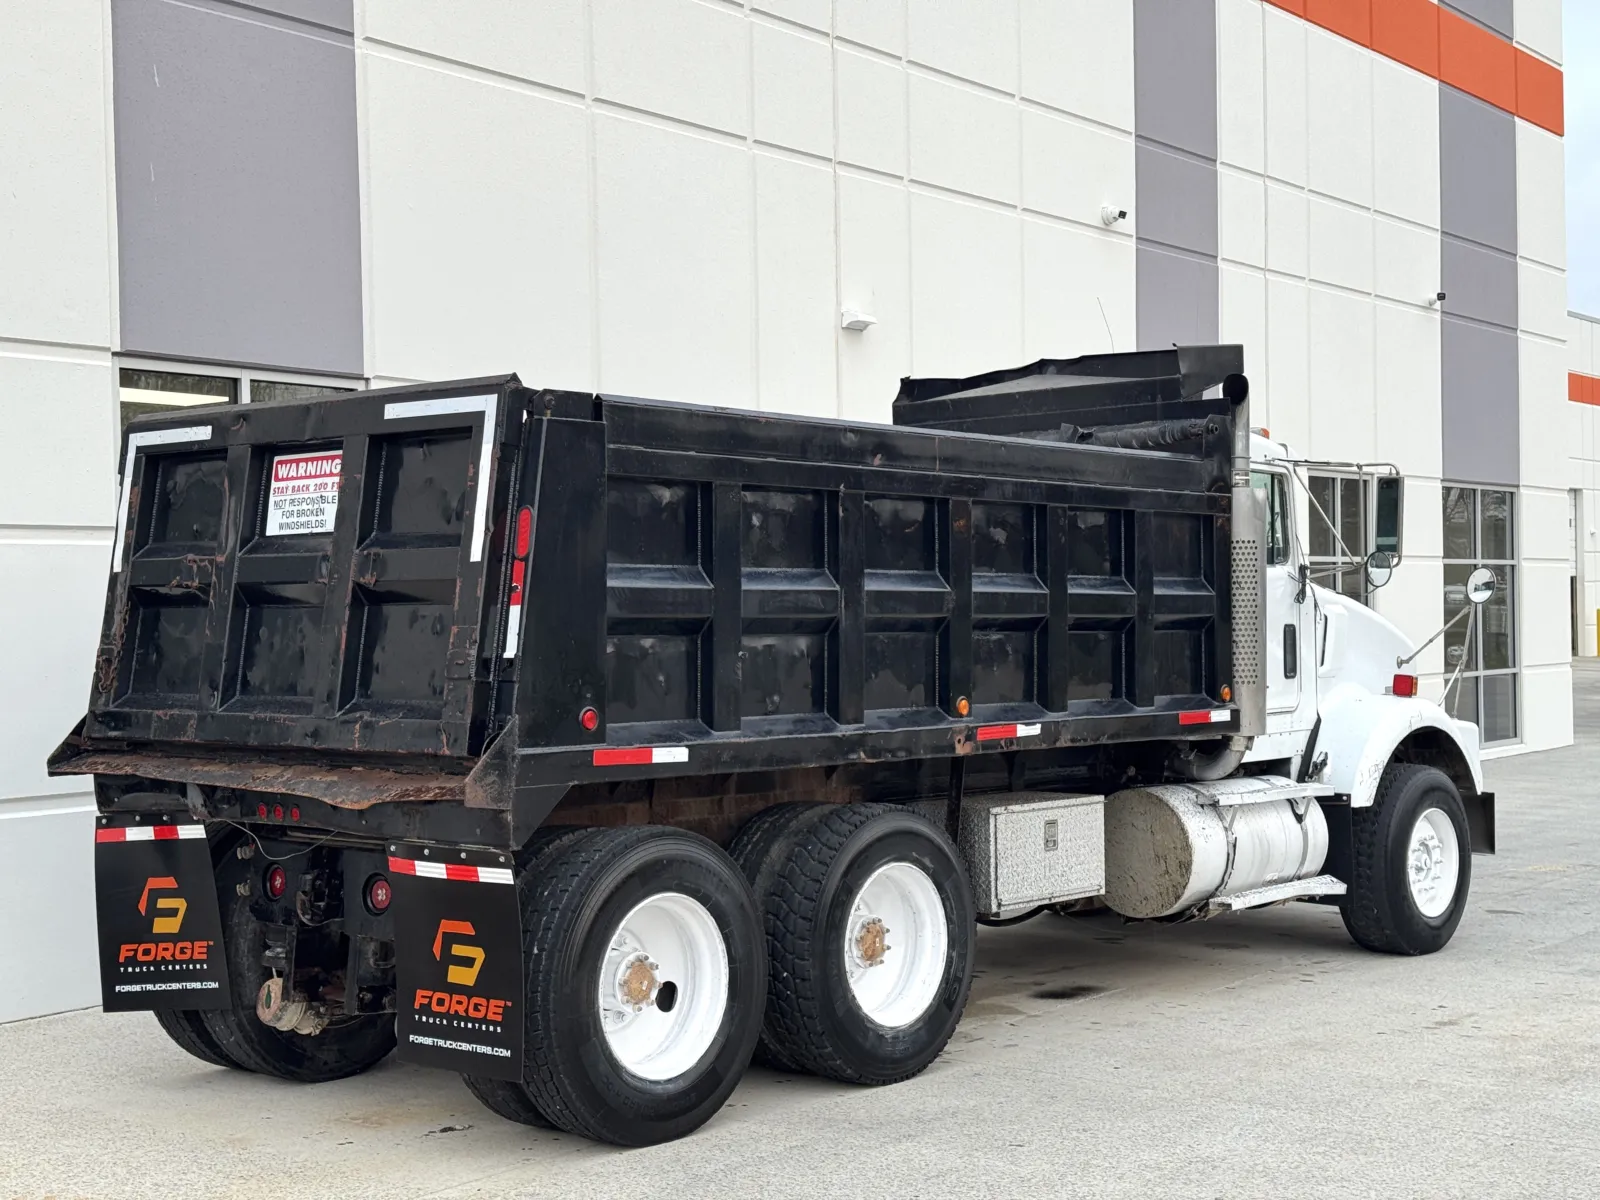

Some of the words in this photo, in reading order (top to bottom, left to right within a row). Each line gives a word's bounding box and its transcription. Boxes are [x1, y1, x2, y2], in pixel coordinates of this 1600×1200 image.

[277, 459, 342, 479] WARNING
[272, 485, 289, 495] STAY
[291, 483, 311, 494] BACK
[313, 482, 328, 491] 200
[273, 498, 288, 509] NOT
[281, 509, 295, 519] FOR
[296, 507, 325, 518] BROKEN
[279, 519, 326, 531] WINDSHIELDS!
[115, 982, 219, 992] FORGETRUCKCENTERS.COM
[415, 1015, 447, 1025] TRUCK
[453, 1021, 501, 1032] CENTERS
[409, 1035, 511, 1058] FORGETRUCKCENTERS.COM
